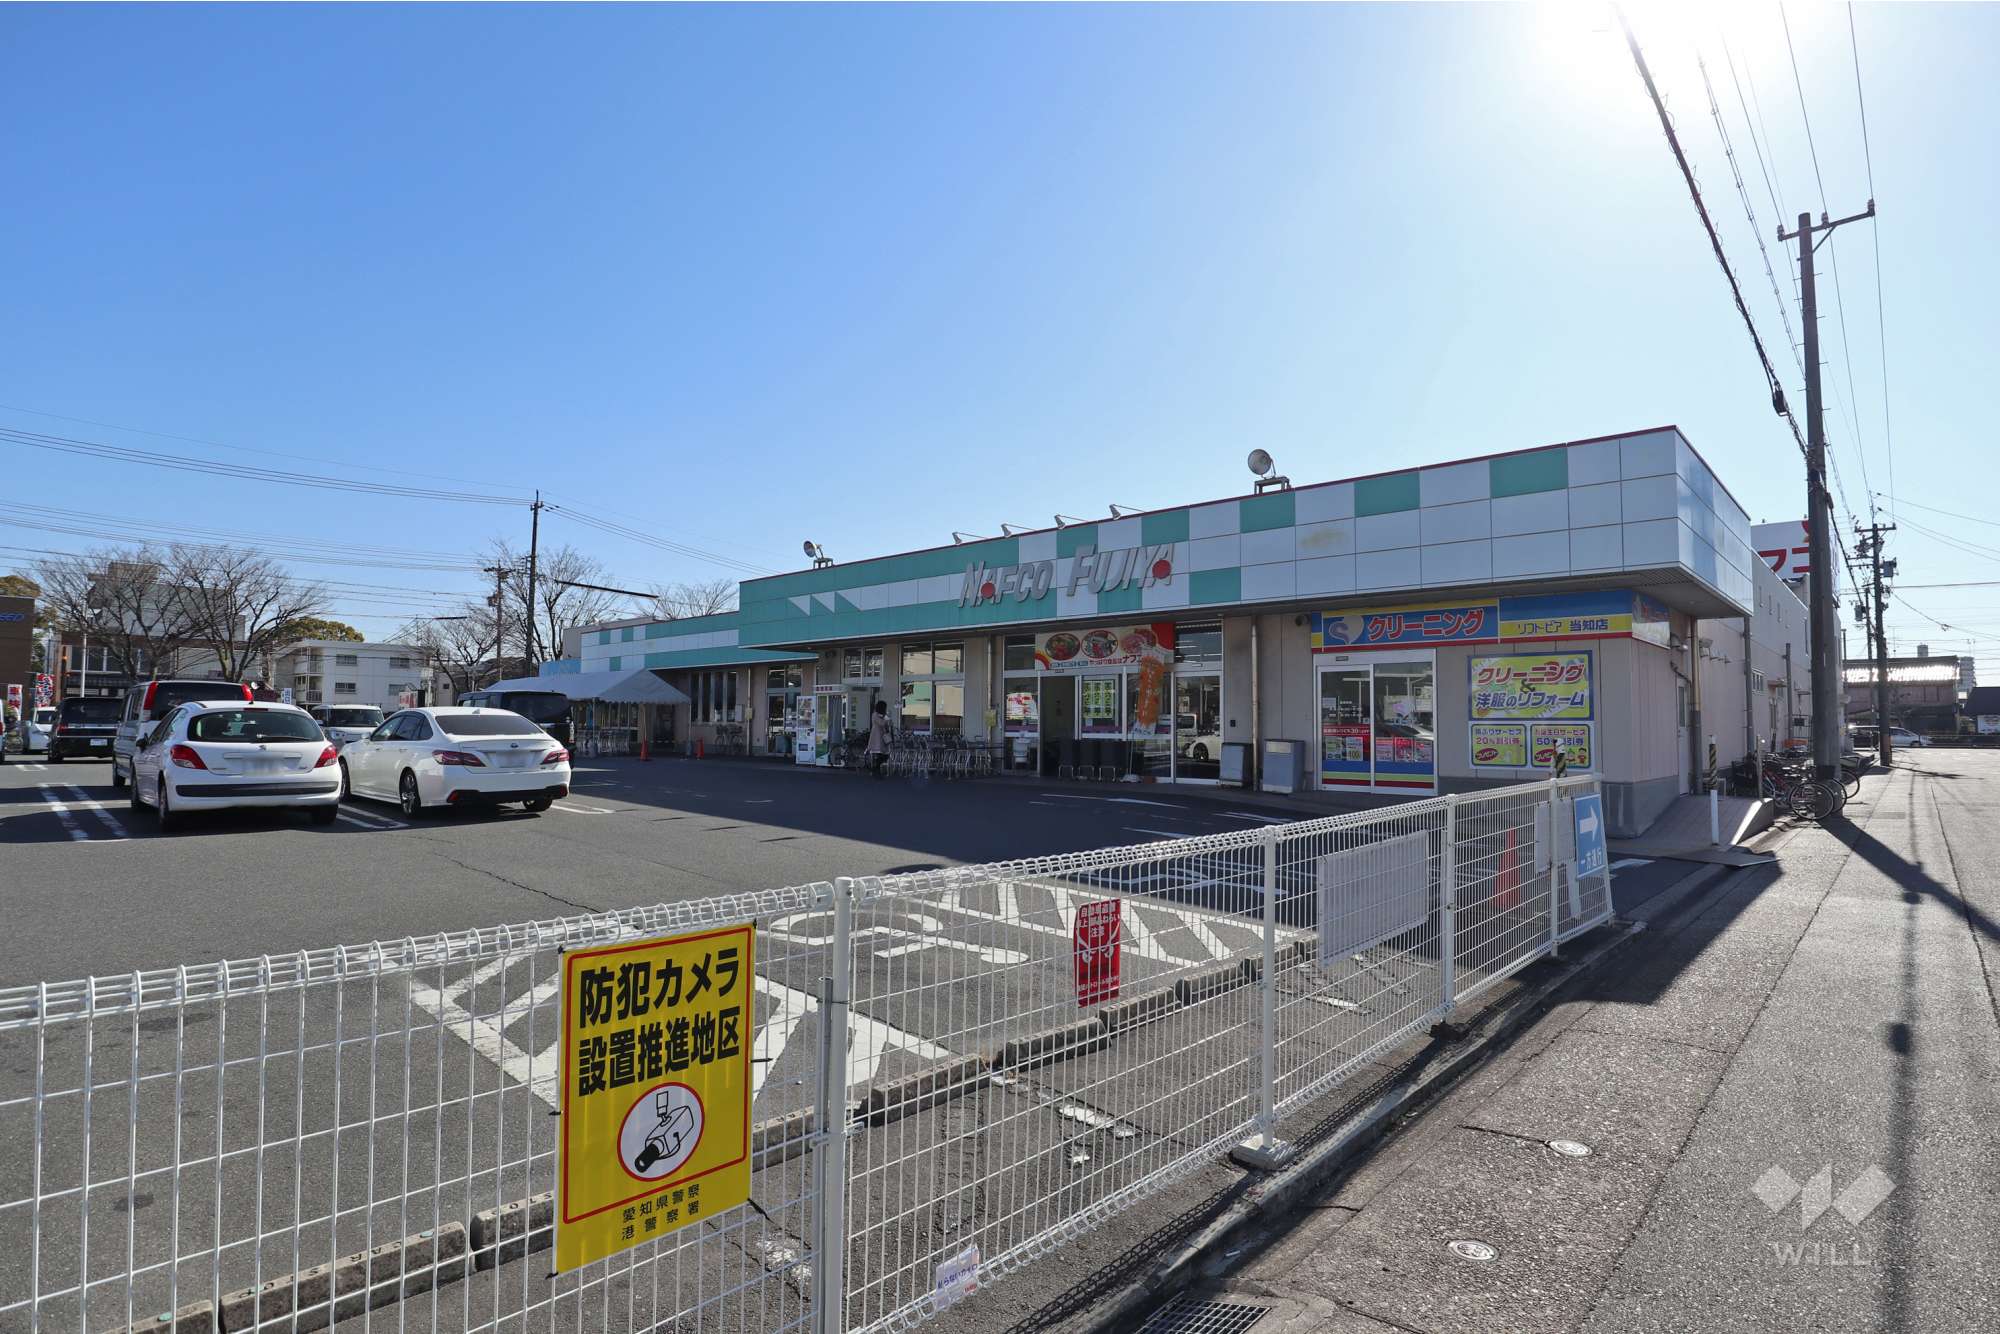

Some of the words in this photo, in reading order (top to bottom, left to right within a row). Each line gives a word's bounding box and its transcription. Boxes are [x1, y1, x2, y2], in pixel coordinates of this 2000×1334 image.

[957, 558, 1054, 608] NAFCO
[1066, 543, 1174, 597] FUJIYA
[1367, 608, 1485, 641] クリーニング
[1569, 618, 1609, 632] 当知店
[1478, 660, 1586, 685] クリーニング
[1520, 678, 1536, 694] &
[1476, 690, 1585, 709] 洋服のリフォーム
[579, 947, 740, 1029] 防犯カメラ
[578, 1005, 741, 1097] 設置推進地区
[621, 1199, 700, 1241] 港警察署
[622, 1183, 700, 1224] 愛知県警察
